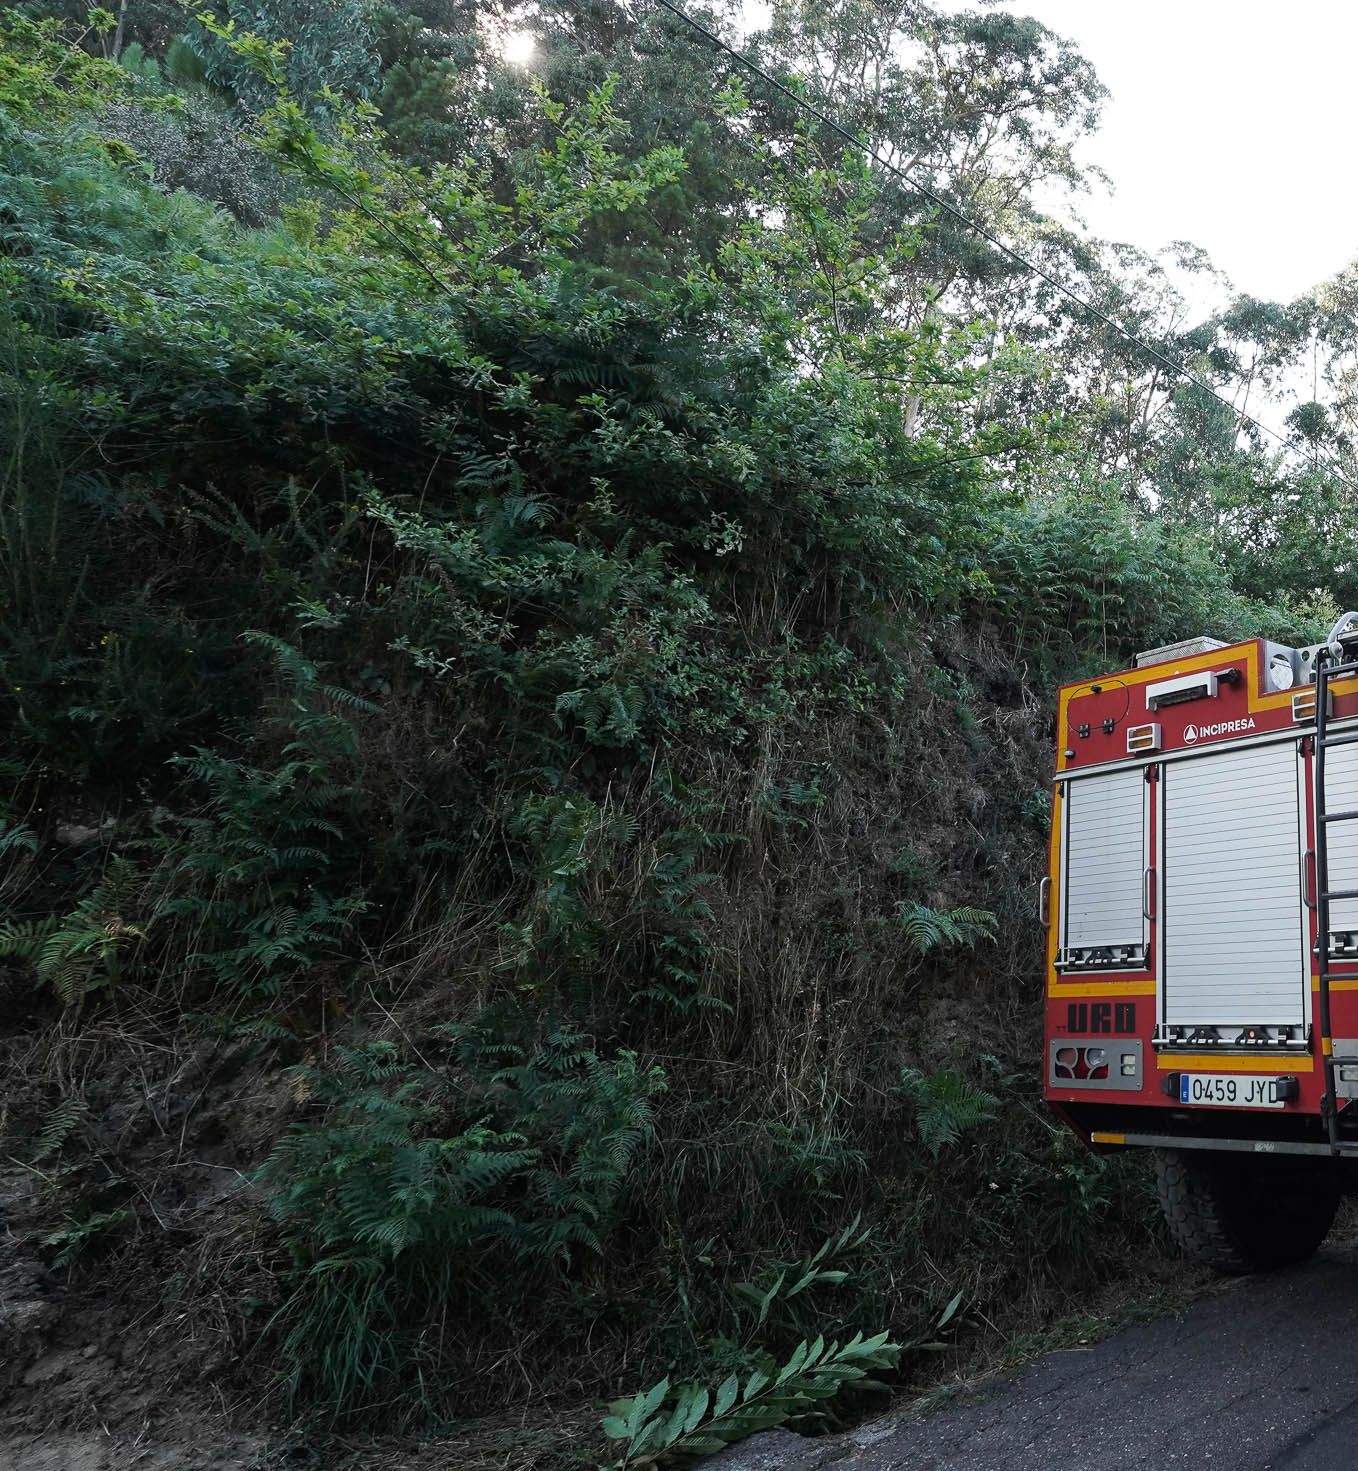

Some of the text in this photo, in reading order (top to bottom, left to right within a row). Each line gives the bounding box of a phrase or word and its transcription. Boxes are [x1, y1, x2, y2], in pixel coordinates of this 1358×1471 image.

[1200, 718, 1256, 738] INCIPRESA
[1067, 1003, 1136, 1033] URO
[1192, 1078, 1279, 1104] 0459 JYD
